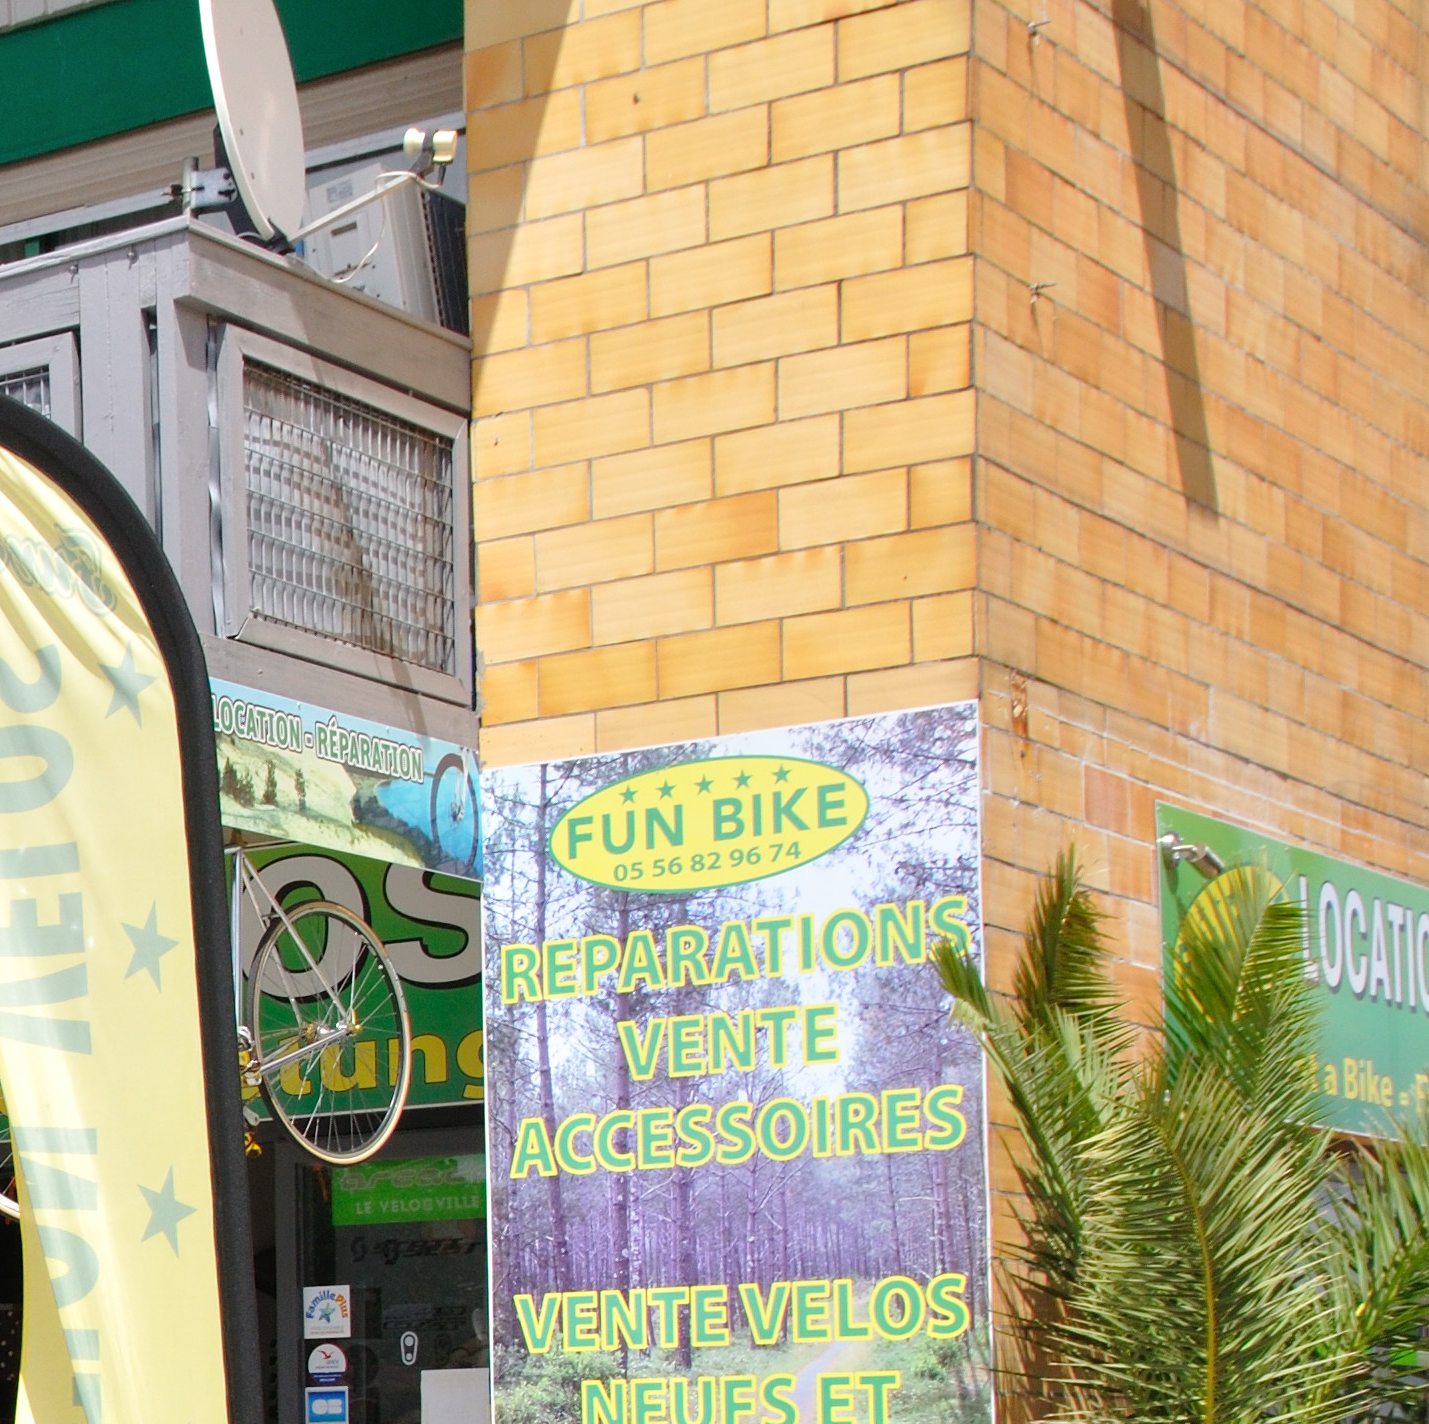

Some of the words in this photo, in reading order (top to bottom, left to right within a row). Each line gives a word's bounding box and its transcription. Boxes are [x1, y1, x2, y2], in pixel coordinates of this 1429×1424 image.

[210, 694, 303, 752] LOCATION
[314, 713, 425, 784] RÉPARATION
[567, 802, 685, 862] FUN
[712, 781, 849, 842] BIKE
[613, 859, 644, 883] 05
[650, 855, 683, 878] 56
[689, 851, 722, 874] 82
[727, 847, 762, 869] 96
[769, 841, 802, 863] 74
[501, 896, 973, 1005] REPARATIONS
[617, 1003, 841, 1081] VENTE
[1344, 1057, 1394, 1108] Bike
[509, 1084, 967, 1179] ACCESSOIRES
[514, 1284, 730, 1355] VENTE
[739, 1273, 972, 1347] VELOS
